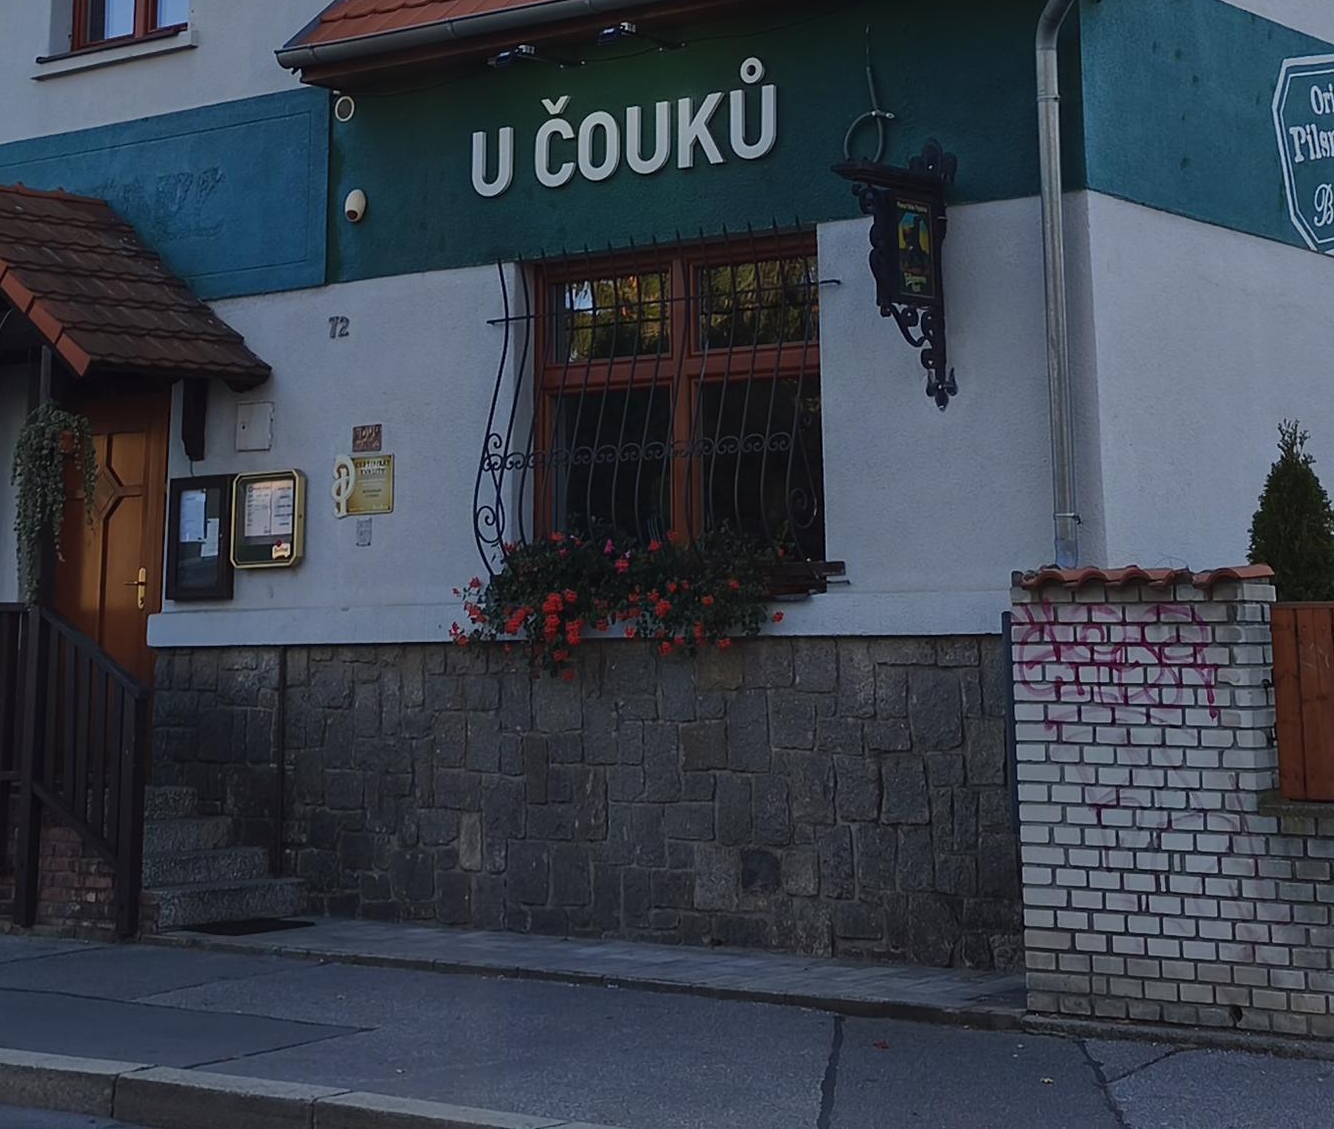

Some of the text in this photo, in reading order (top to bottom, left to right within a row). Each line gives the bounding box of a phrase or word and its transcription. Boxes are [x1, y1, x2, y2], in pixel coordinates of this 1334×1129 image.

[471, 57, 777, 198] U ČOUKŮ
[328, 316, 349, 339] 72
